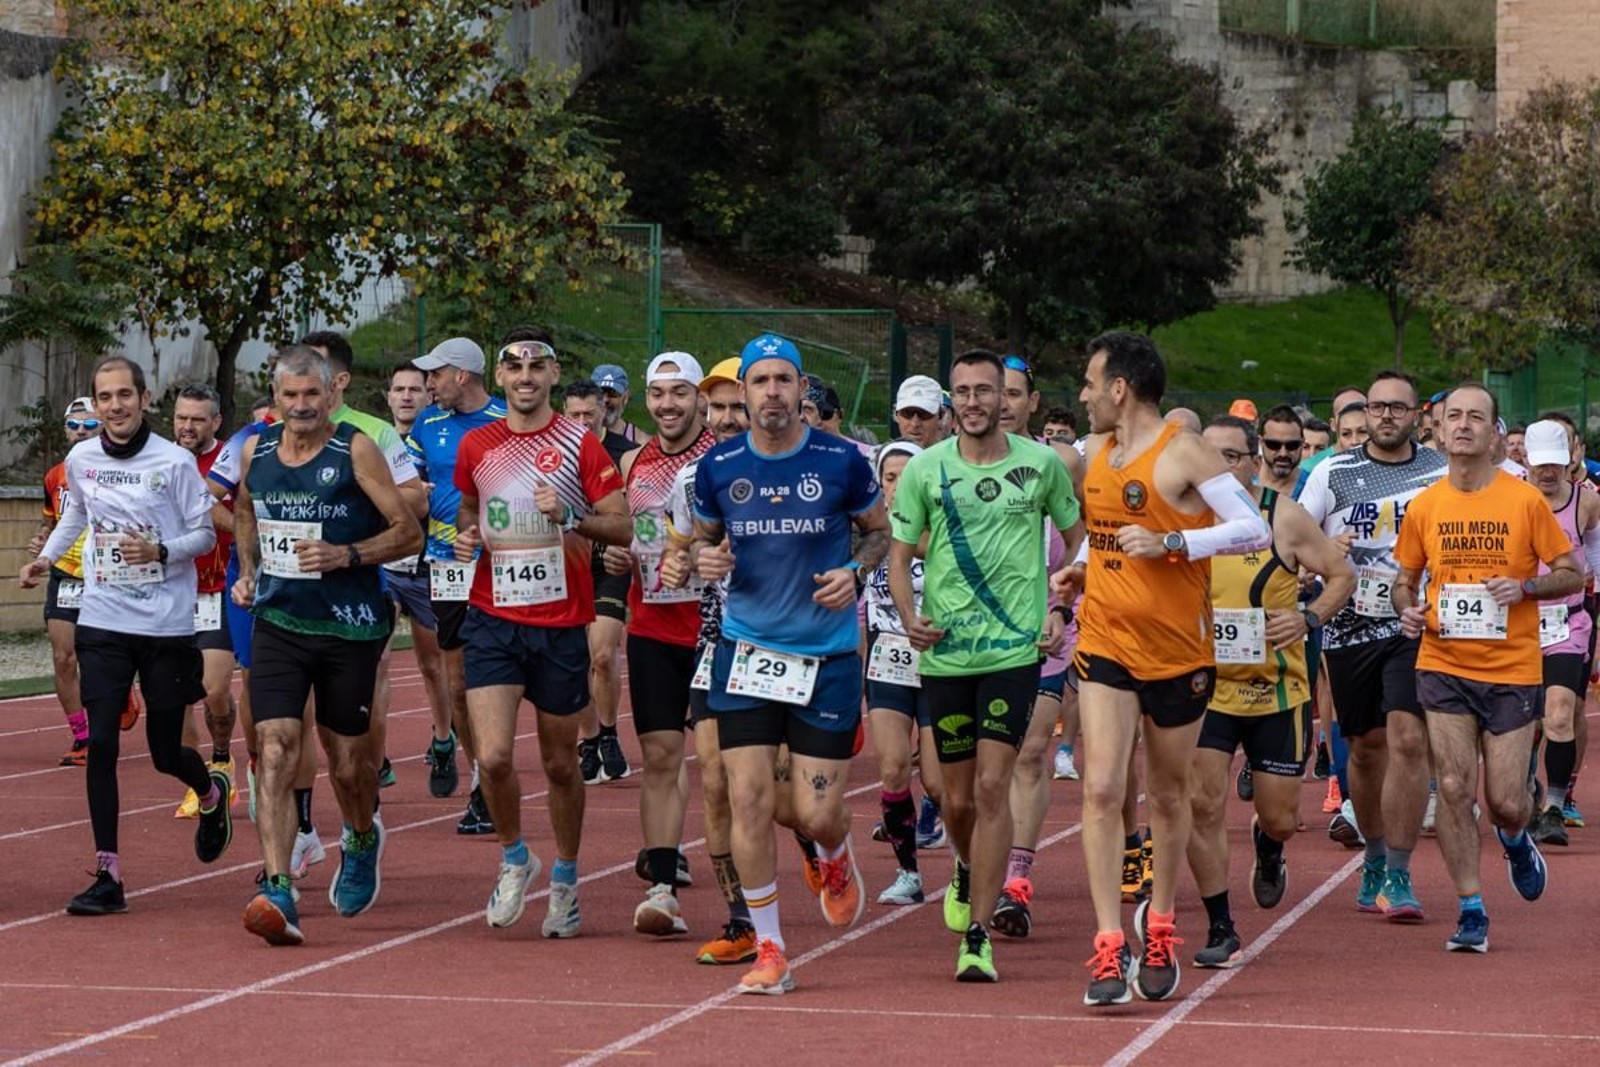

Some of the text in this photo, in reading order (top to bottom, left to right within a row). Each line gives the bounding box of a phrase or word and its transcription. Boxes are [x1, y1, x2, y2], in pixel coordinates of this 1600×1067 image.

[97, 475, 141, 485] PUENTES
[265, 491, 319, 505] RUNNING
[760, 487, 790, 497] RA 28
[746, 517, 825, 536] BULEVAR
[1438, 521, 1510, 536] XXIII MEDIA
[1441, 536, 1505, 551] MARATON
[446, 568, 465, 583] 81
[506, 563, 547, 583] 146
[1456, 599, 1483, 616] 94
[889, 648, 913, 666] 33
[756, 658, 787, 678] 29
